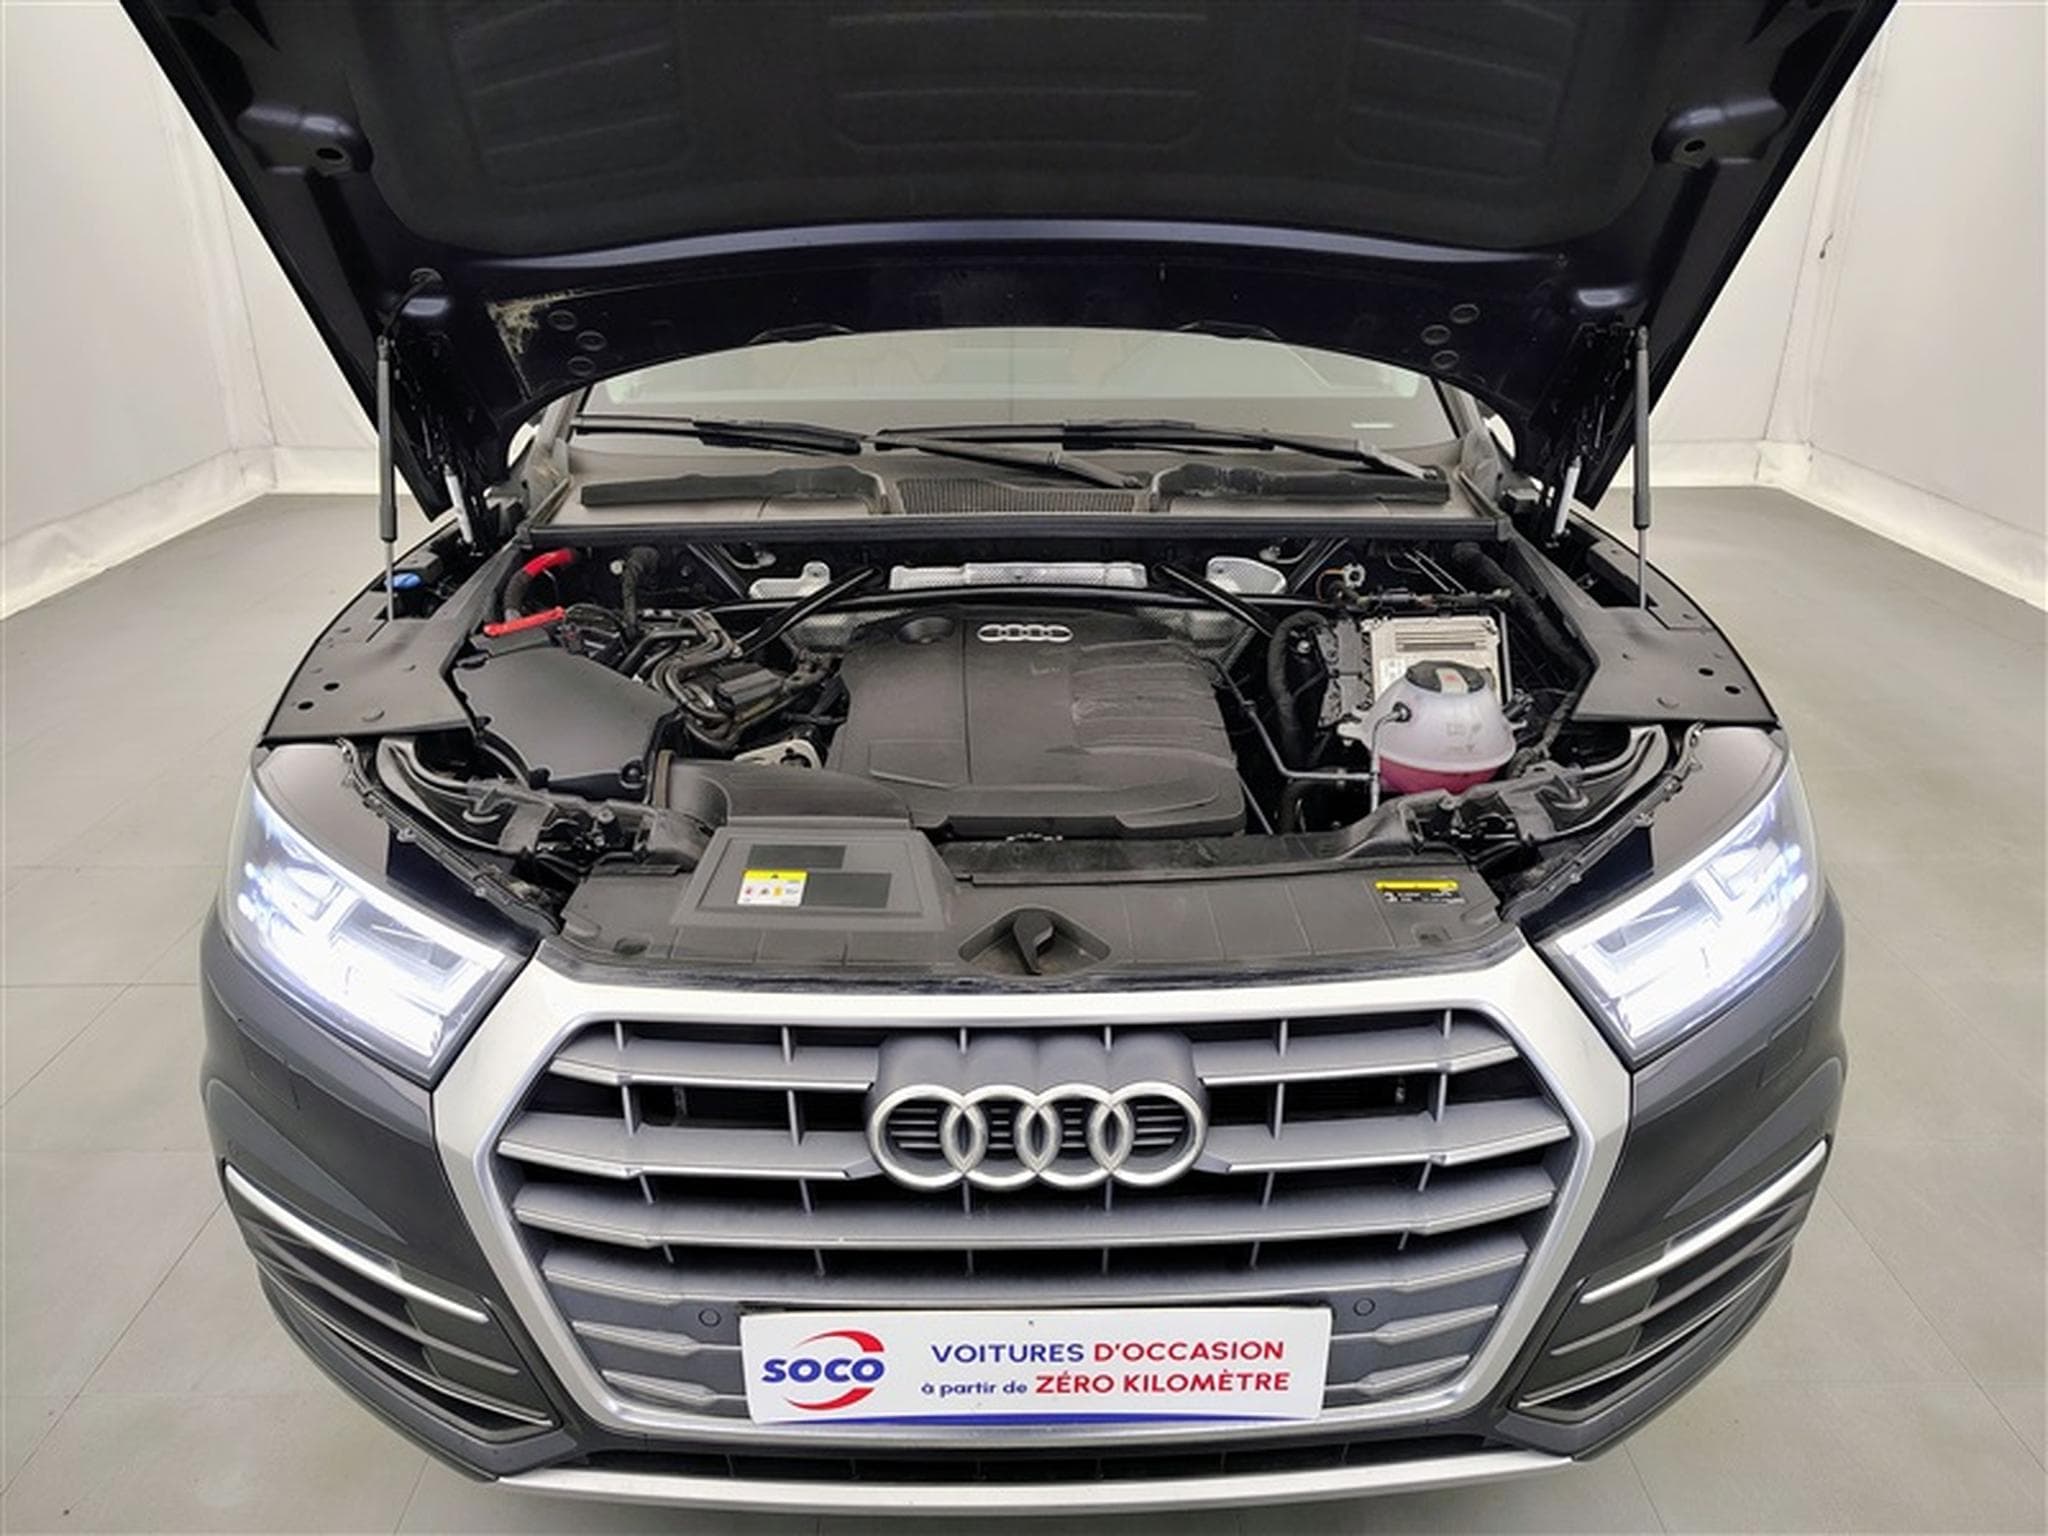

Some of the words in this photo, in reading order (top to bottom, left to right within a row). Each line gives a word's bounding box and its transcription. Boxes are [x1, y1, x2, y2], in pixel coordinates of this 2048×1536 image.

[930, 1343, 1084, 1363] VOITURES
[1093, 1341, 1284, 1362] D'OCCASION
[761, 1357, 884, 1383] SOCO
[921, 1380, 934, 1394] à
[940, 1381, 996, 1398] partir
[1002, 1380, 1027, 1394] de
[1035, 1370, 1114, 1393] ZÉRO
[1123, 1368, 1289, 1392] KILOMÈTRE
